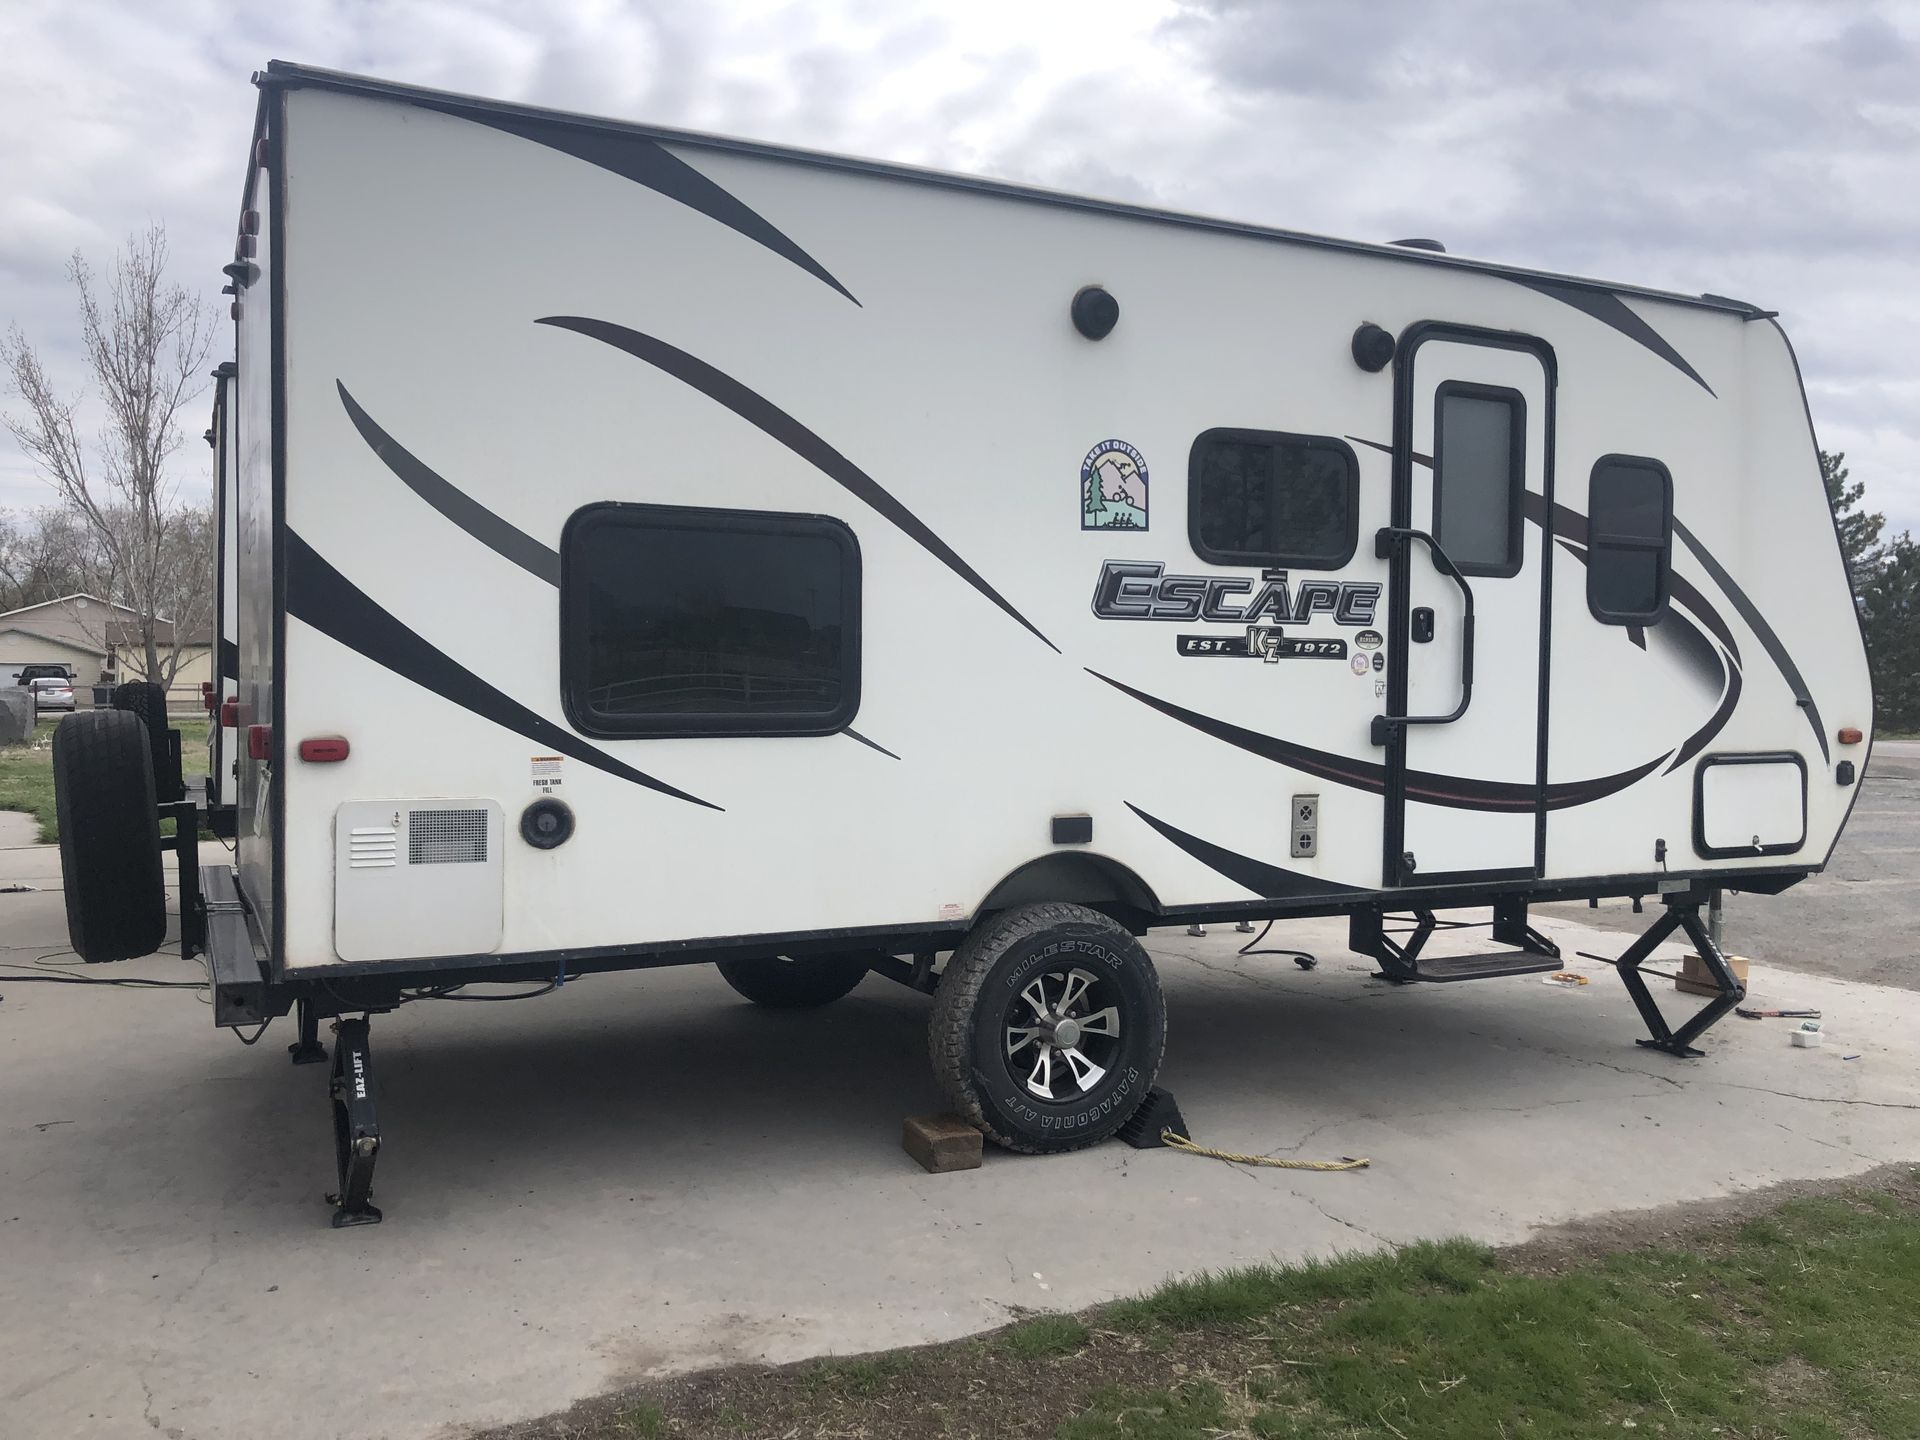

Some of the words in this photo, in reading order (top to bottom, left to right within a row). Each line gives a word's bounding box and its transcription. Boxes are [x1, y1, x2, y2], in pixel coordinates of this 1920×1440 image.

[1083, 447, 1102, 472] TAKE
[1101, 441, 1111, 451] IT
[1112, 441, 1147, 474] OUTSIDE
[1091, 558, 1383, 626] ESCAPE
[1186, 639, 1231, 651] EST.
[1293, 642, 1341, 654] 1972
[1007, 940, 1123, 988] MILESTAR
[352, 1051, 366, 1098] EAZ-LIFT
[1041, 1066, 1139, 1129] PATAGONIA
[1005, 1096, 1038, 1122] A/T
